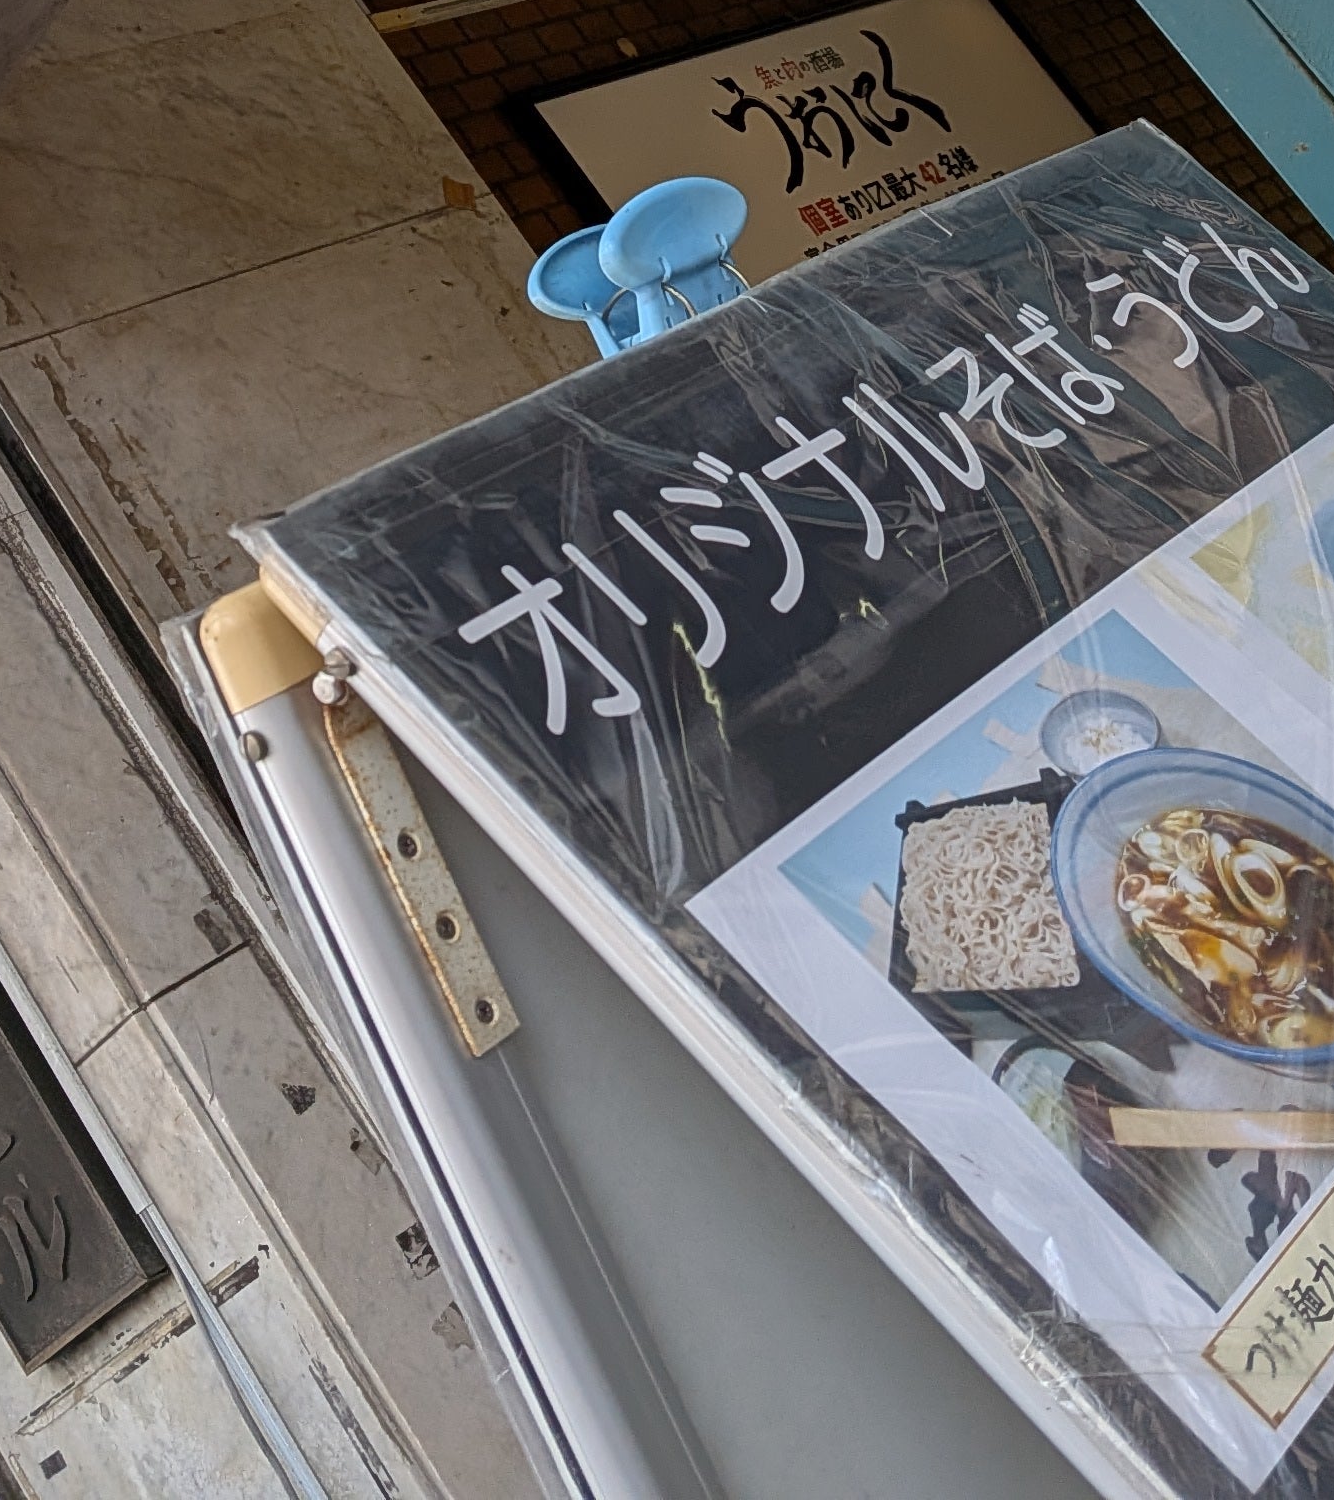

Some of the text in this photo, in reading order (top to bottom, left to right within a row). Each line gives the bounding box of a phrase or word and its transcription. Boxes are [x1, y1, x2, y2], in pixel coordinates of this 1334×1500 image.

[711, 29, 952, 195] うおにく
[754, 46, 846, 91] 魚と肉の酒場
